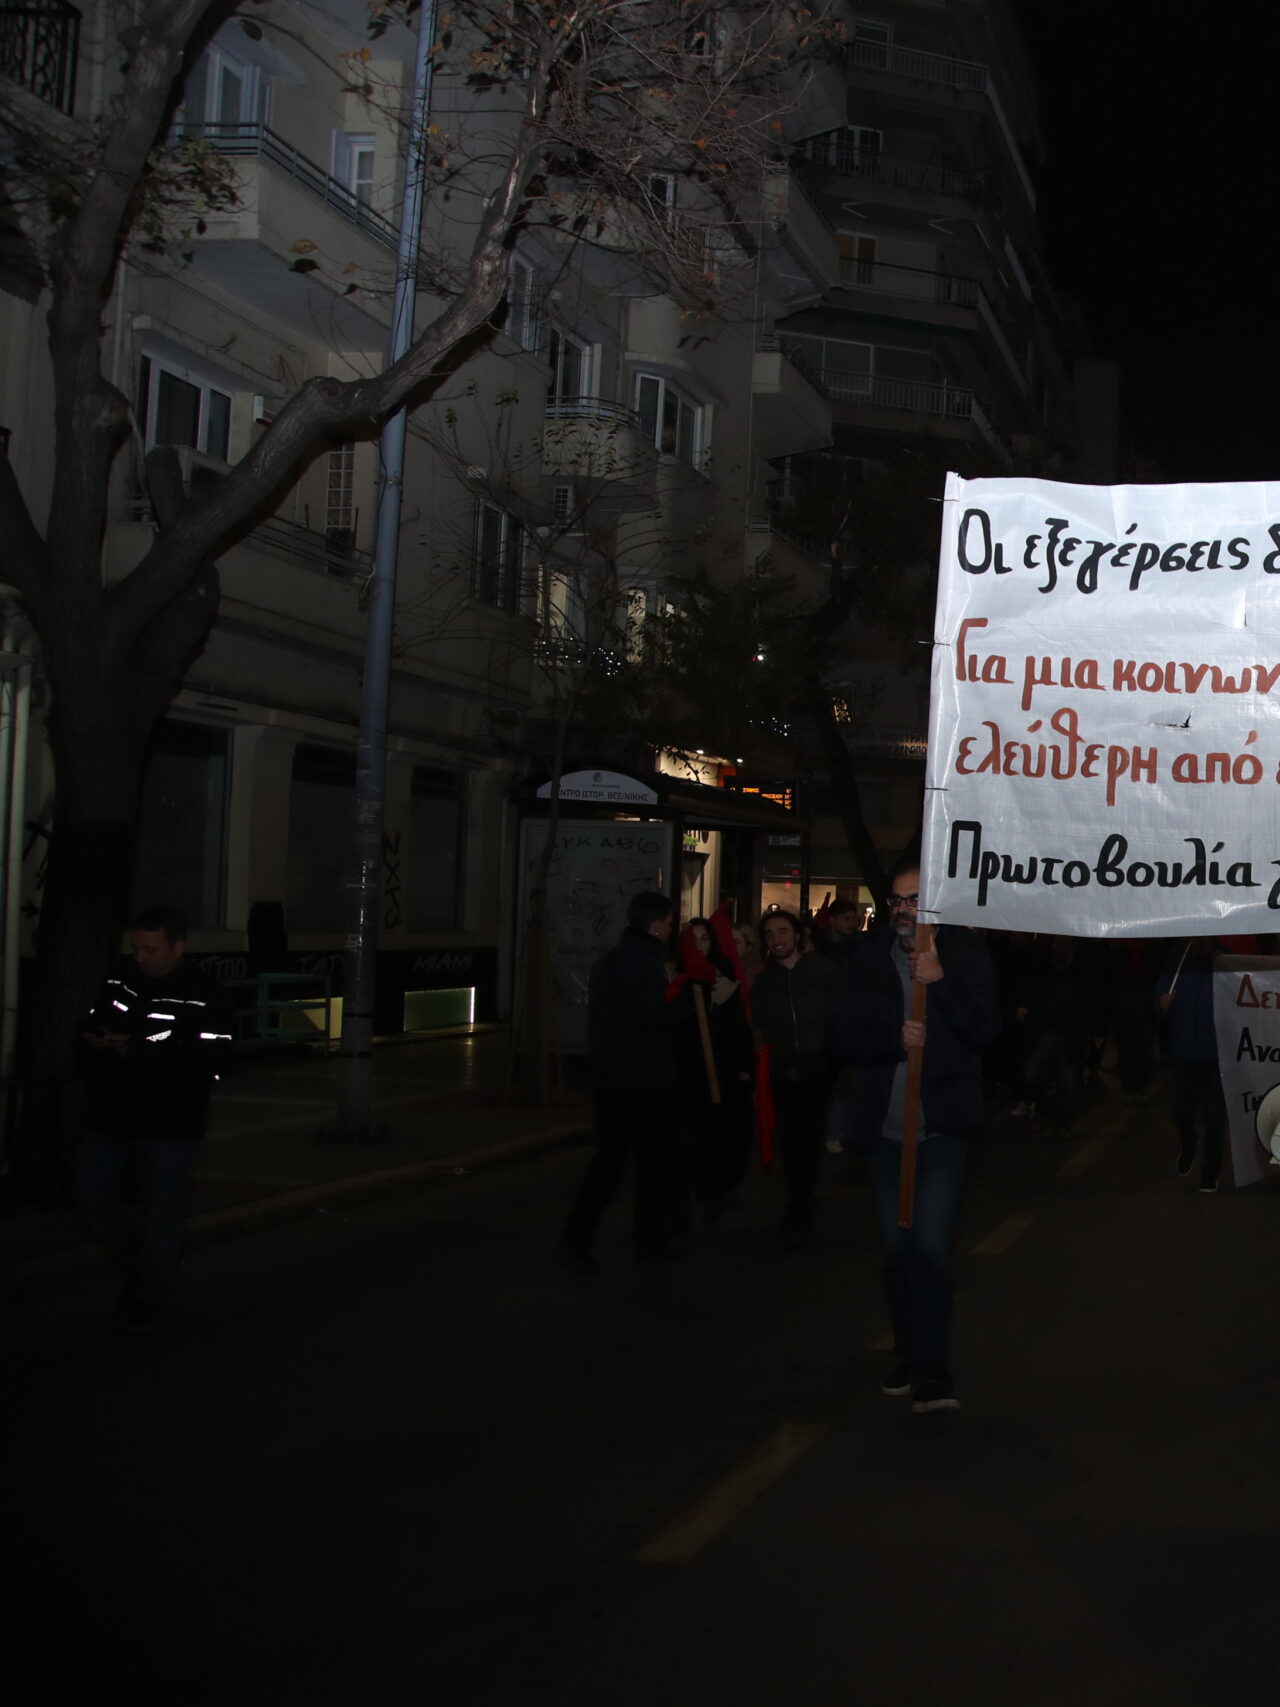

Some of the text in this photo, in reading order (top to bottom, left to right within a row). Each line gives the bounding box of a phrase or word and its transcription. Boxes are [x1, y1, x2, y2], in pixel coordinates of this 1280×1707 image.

[957, 508, 1012, 575] Οι
[1024, 517, 1251, 594] εξεγέρσεις
[956, 617, 1015, 685] Για
[1021, 655, 1107, 712] μια
[955, 707, 1158, 807] ελεύθερη
[1172, 731, 1264, 786] από
[948, 820, 1262, 906] Πρωτοβουλία
